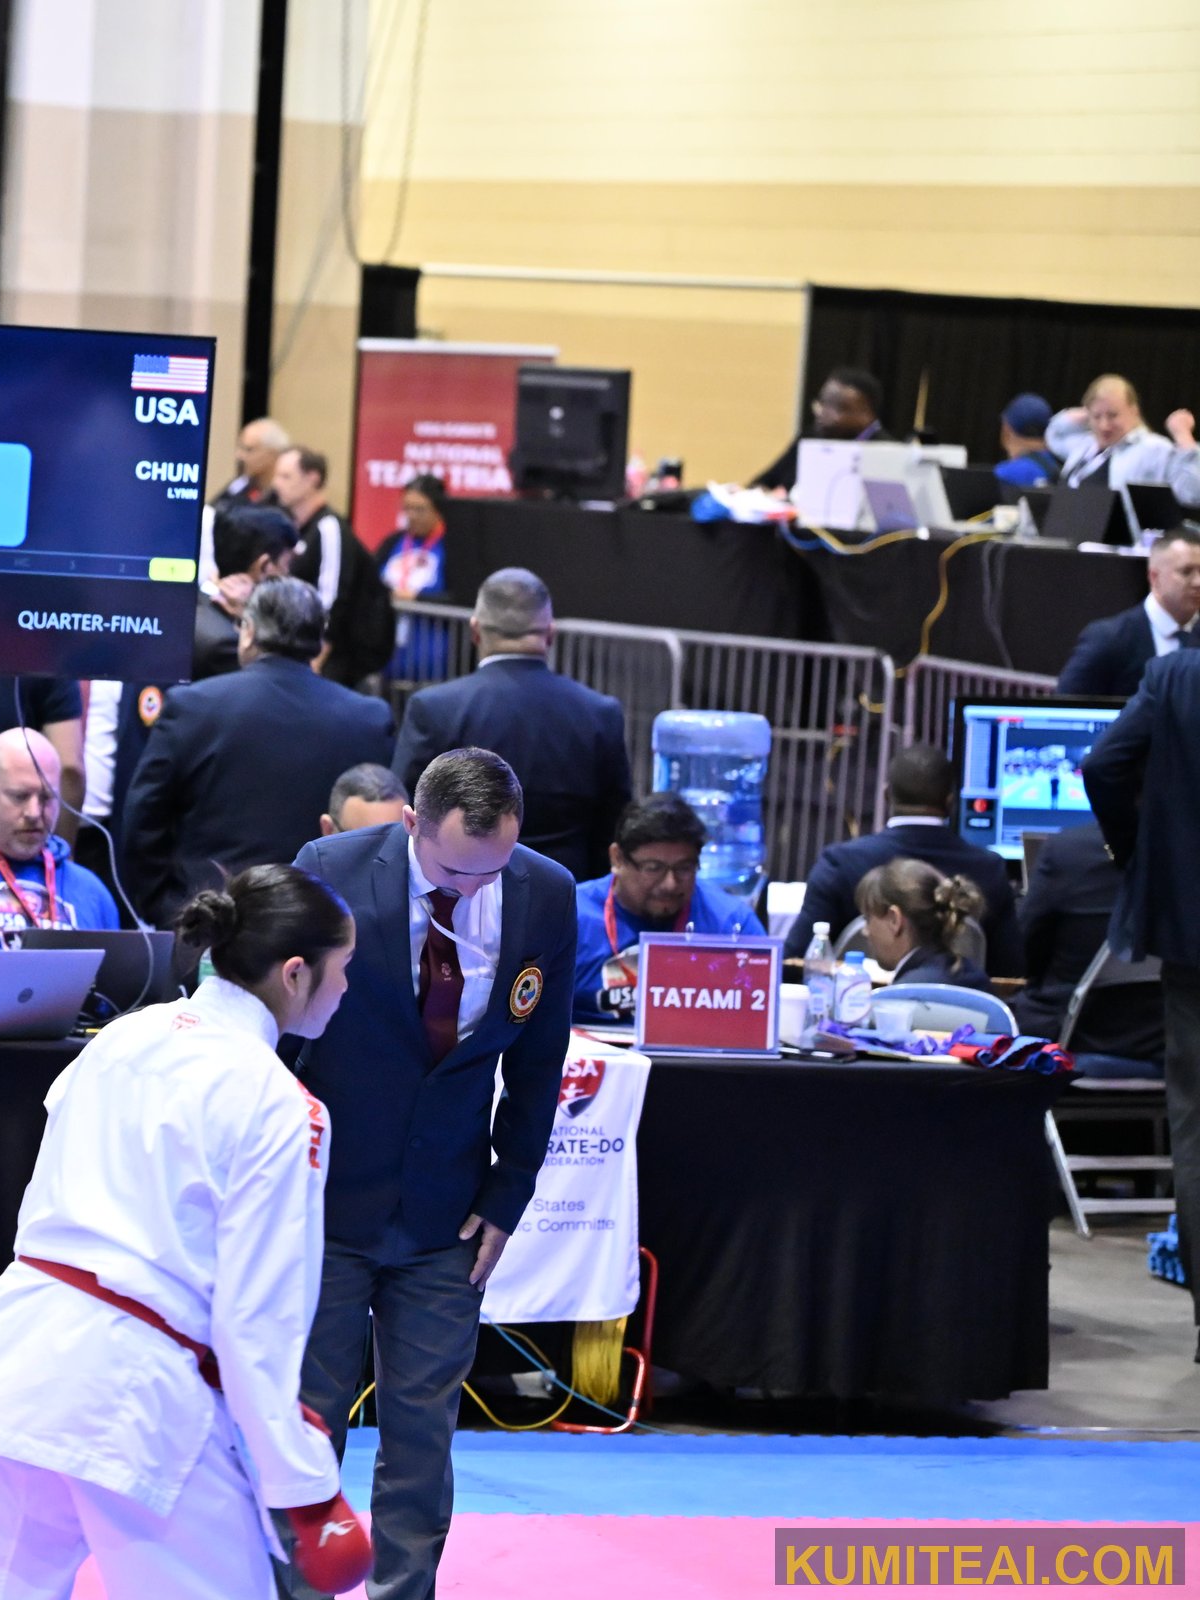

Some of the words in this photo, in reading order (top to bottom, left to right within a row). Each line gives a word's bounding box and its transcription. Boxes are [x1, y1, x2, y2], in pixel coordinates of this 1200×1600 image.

[135, 396, 200, 426] USA
[135, 460, 199, 483] CHUN
[449, 464, 513, 491] TRIA
[167, 487, 198, 500] LYNN
[18, 610, 163, 635] QUARTER-FINAL
[650, 986, 742, 1010] TATAMI
[751, 989, 765, 1011] 2
[550, 1126, 605, 1137] ATIONAL
[547, 1138, 624, 1155] RATE-DO
[544, 1156, 605, 1167] EDERATION
[533, 1197, 585, 1213] States
